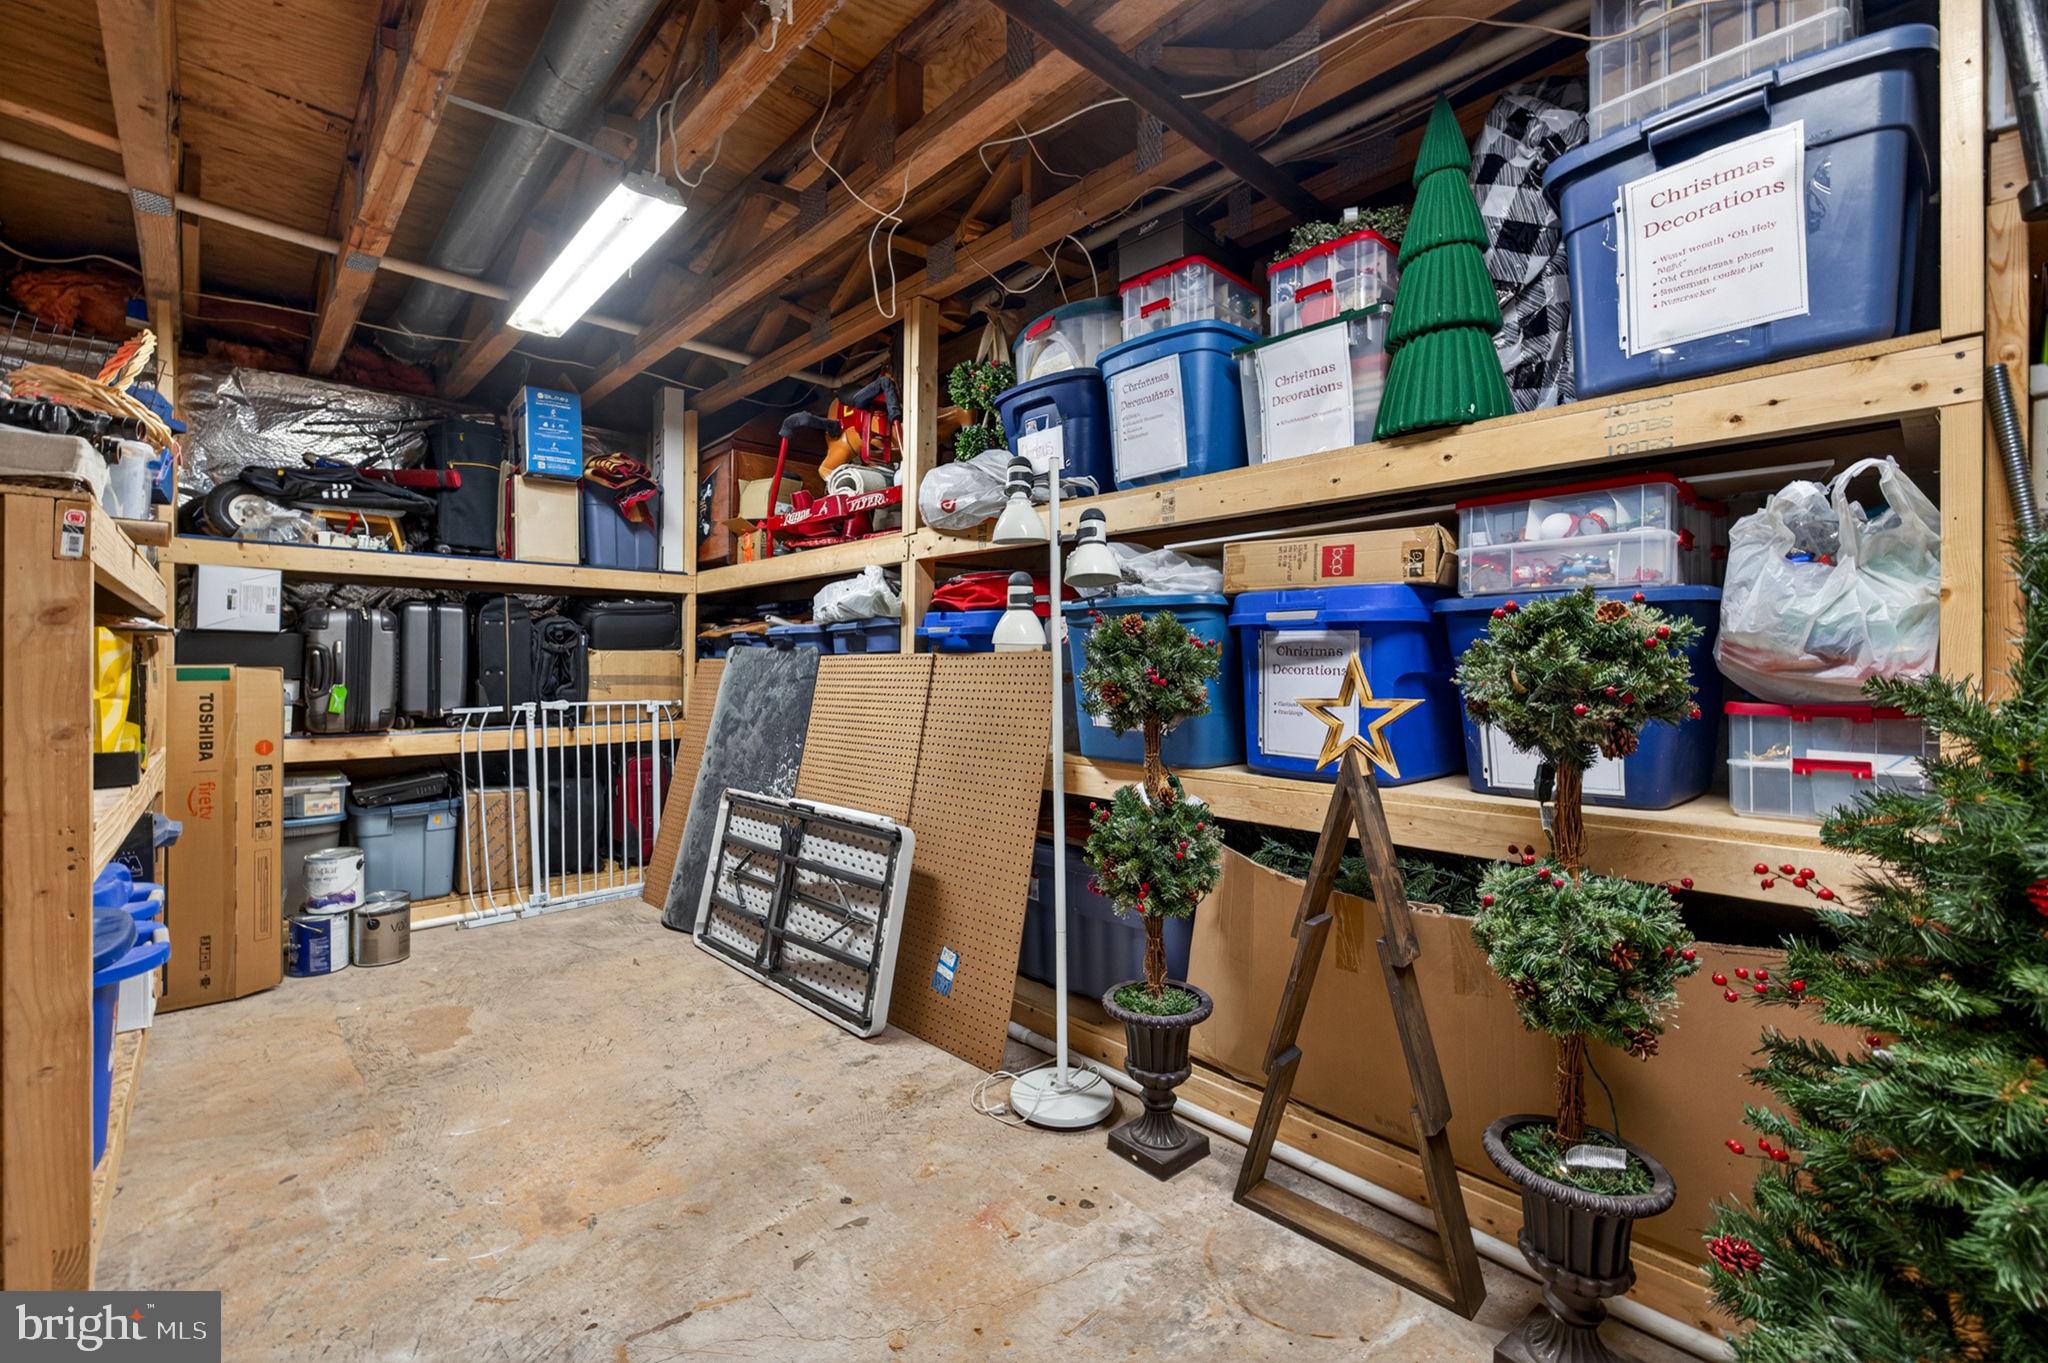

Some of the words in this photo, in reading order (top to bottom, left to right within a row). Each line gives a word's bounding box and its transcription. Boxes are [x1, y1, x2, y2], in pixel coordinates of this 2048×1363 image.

[1650, 155, 1775, 209] Christmas
[1643, 179, 1786, 239] Decorations
[1679, 258, 1734, 278] Christmas
[1275, 363, 1336, 388] Christmas
[1272, 381, 1344, 408] Decorations
[1276, 645, 1344, 657] Christmas
[1272, 663, 1347, 676] Decorations
[199, 692, 214, 762] TOSHIBA
